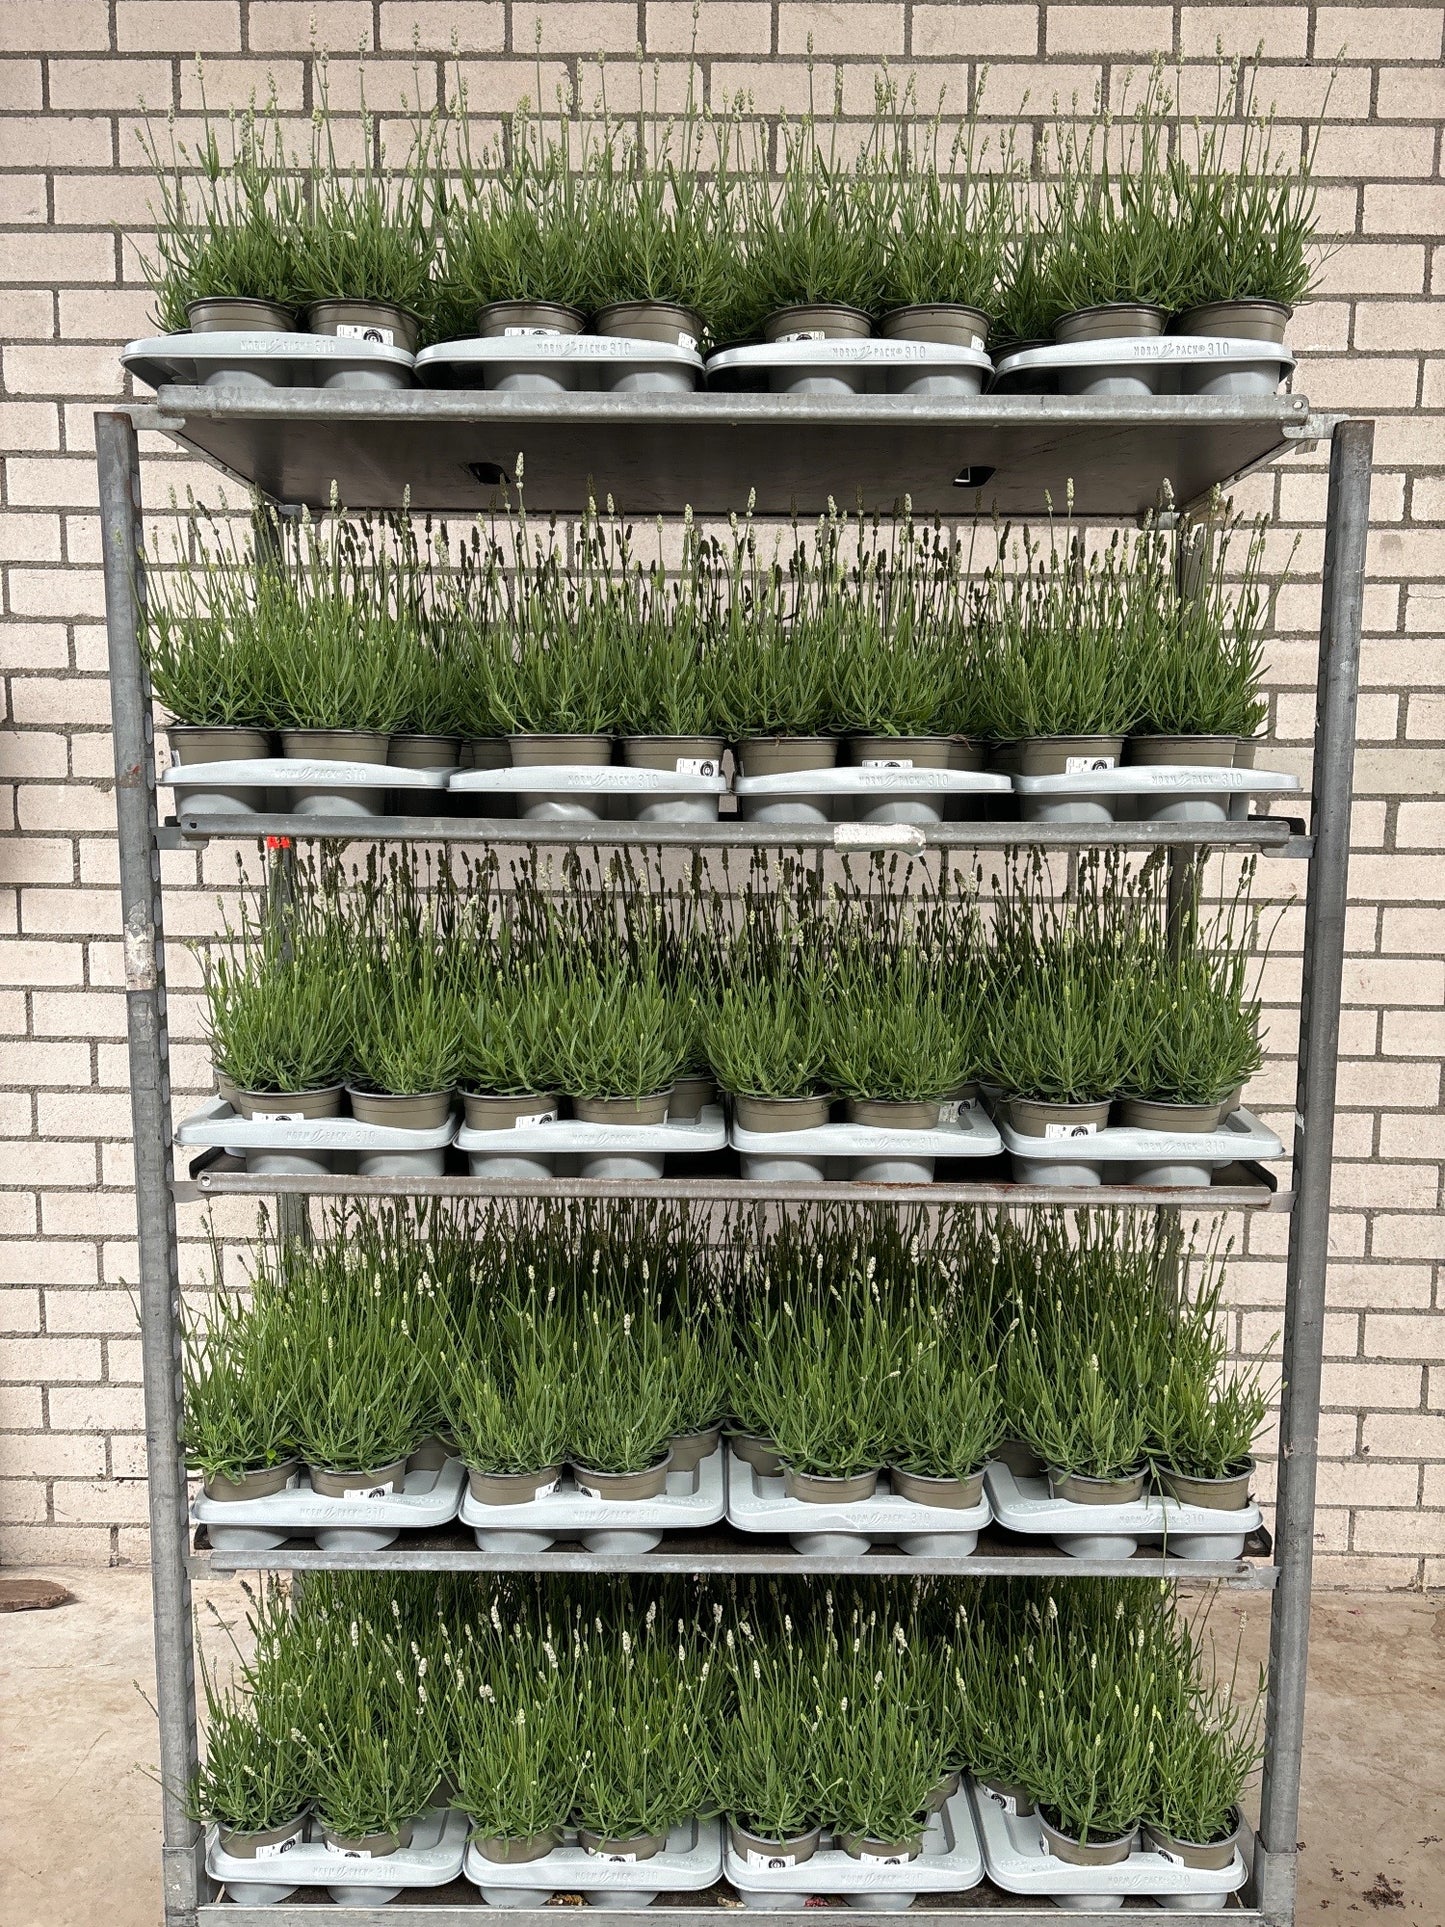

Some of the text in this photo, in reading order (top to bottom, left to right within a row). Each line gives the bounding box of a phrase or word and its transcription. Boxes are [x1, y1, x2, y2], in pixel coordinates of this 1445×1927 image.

[610, 342, 631, 355] 310
[832, 347, 858, 358] NORM
[905, 346, 926, 360] 310
[1133, 345, 1159, 356] NORM
[1208, 342, 1230, 356] 310
[346, 768, 366, 781] 310
[639, 774, 659, 788] 310
[929, 773, 949, 787] 310
[1221, 773, 1243, 787] 310
